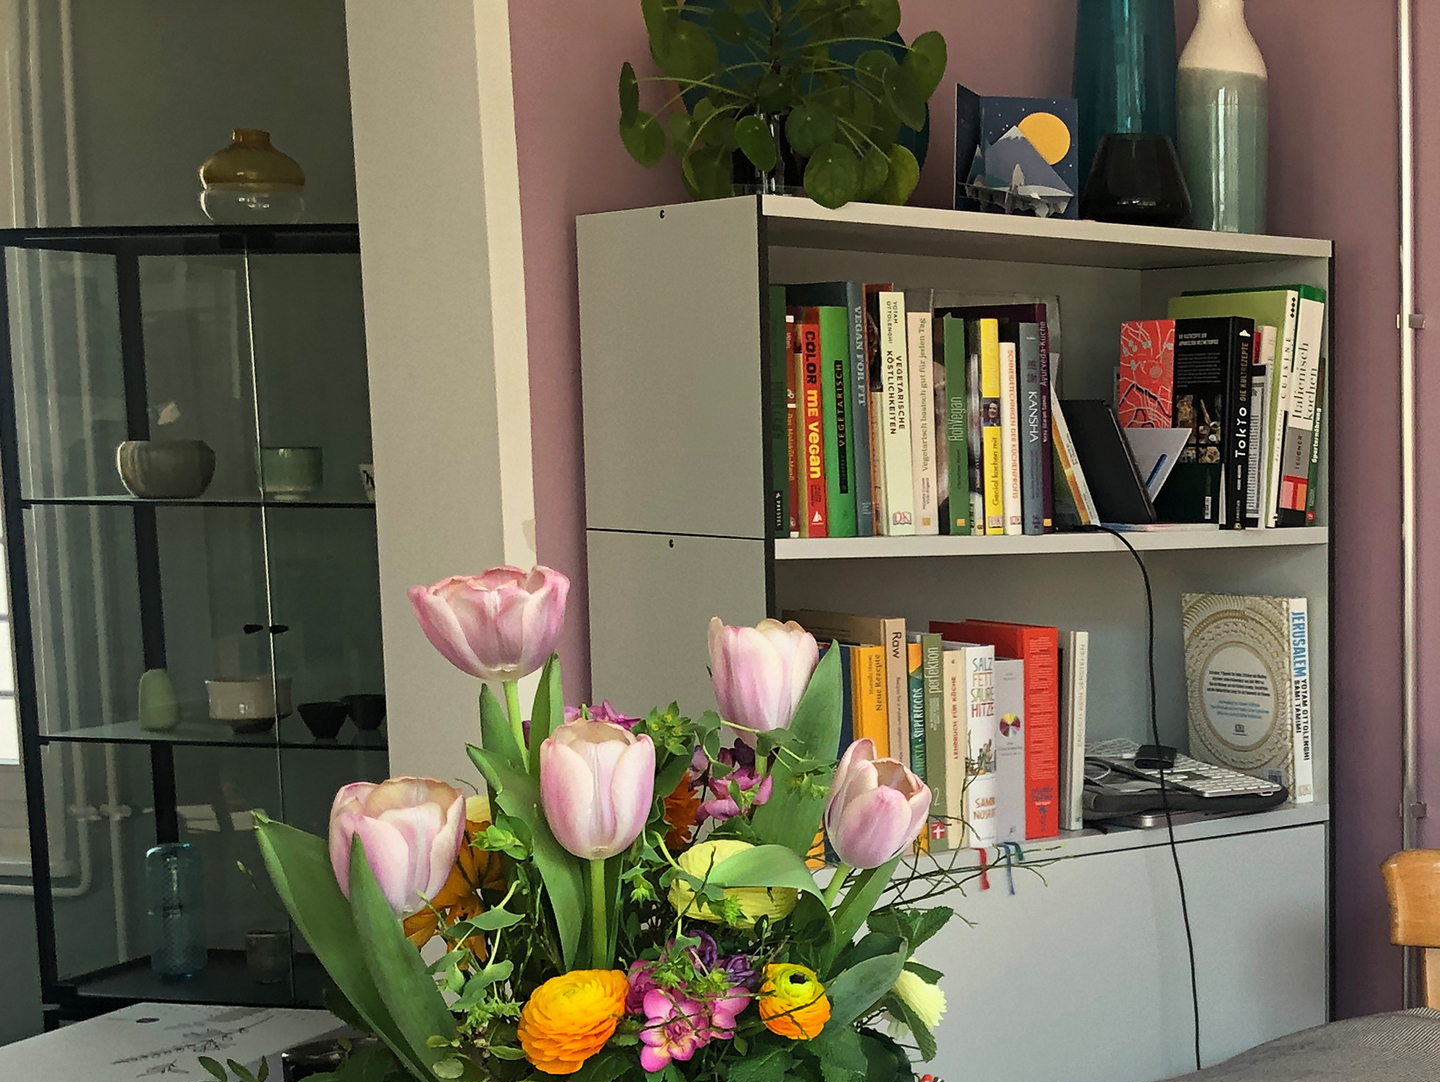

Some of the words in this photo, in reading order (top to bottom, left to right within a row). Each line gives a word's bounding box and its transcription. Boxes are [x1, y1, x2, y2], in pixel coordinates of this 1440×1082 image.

[854, 306, 863, 350] VEGAN
[805, 331, 817, 384] COLOR
[856, 354, 865, 381] FOR
[1239, 342, 1249, 388] KULTREZEPTE
[1281, 338, 1291, 399] CUISINE
[1292, 342, 1309, 419] Italienisch
[835, 363, 846, 447] VEGETARISCH
[858, 385, 866, 406] FIT
[886, 350, 896, 435] KÖSTLICHKEITEN
[895, 355, 905, 430] VEGETARISCHE
[1007, 350, 1016, 427] SCHNEIDETECHNIKEN
[1239, 389, 1247, 401] DIE
[1303, 367, 1317, 421] kochen
[948, 396, 966, 441] RohVegan
[1028, 391, 1039, 443] KANSHA
[920, 423, 929, 472] Vegetarisch
[891, 631, 902, 659] Raw
[972, 657, 993, 673] SALZ
[1291, 611, 1307, 677] JERUSALEM
[875, 654, 883, 687] Rezepte
[924, 647, 942, 694] perfektion
[1293, 680, 1301, 699] SAMI
[1300, 679, 1308, 707] YOTAM
[913, 687, 924, 738] SUPERFOODS
[972, 702, 994, 718] HITZE
[1294, 703, 1302, 734] TAMIMI
[1301, 709, 1310, 761] OTTOLENGHI
[933, 787, 940, 807] 2
